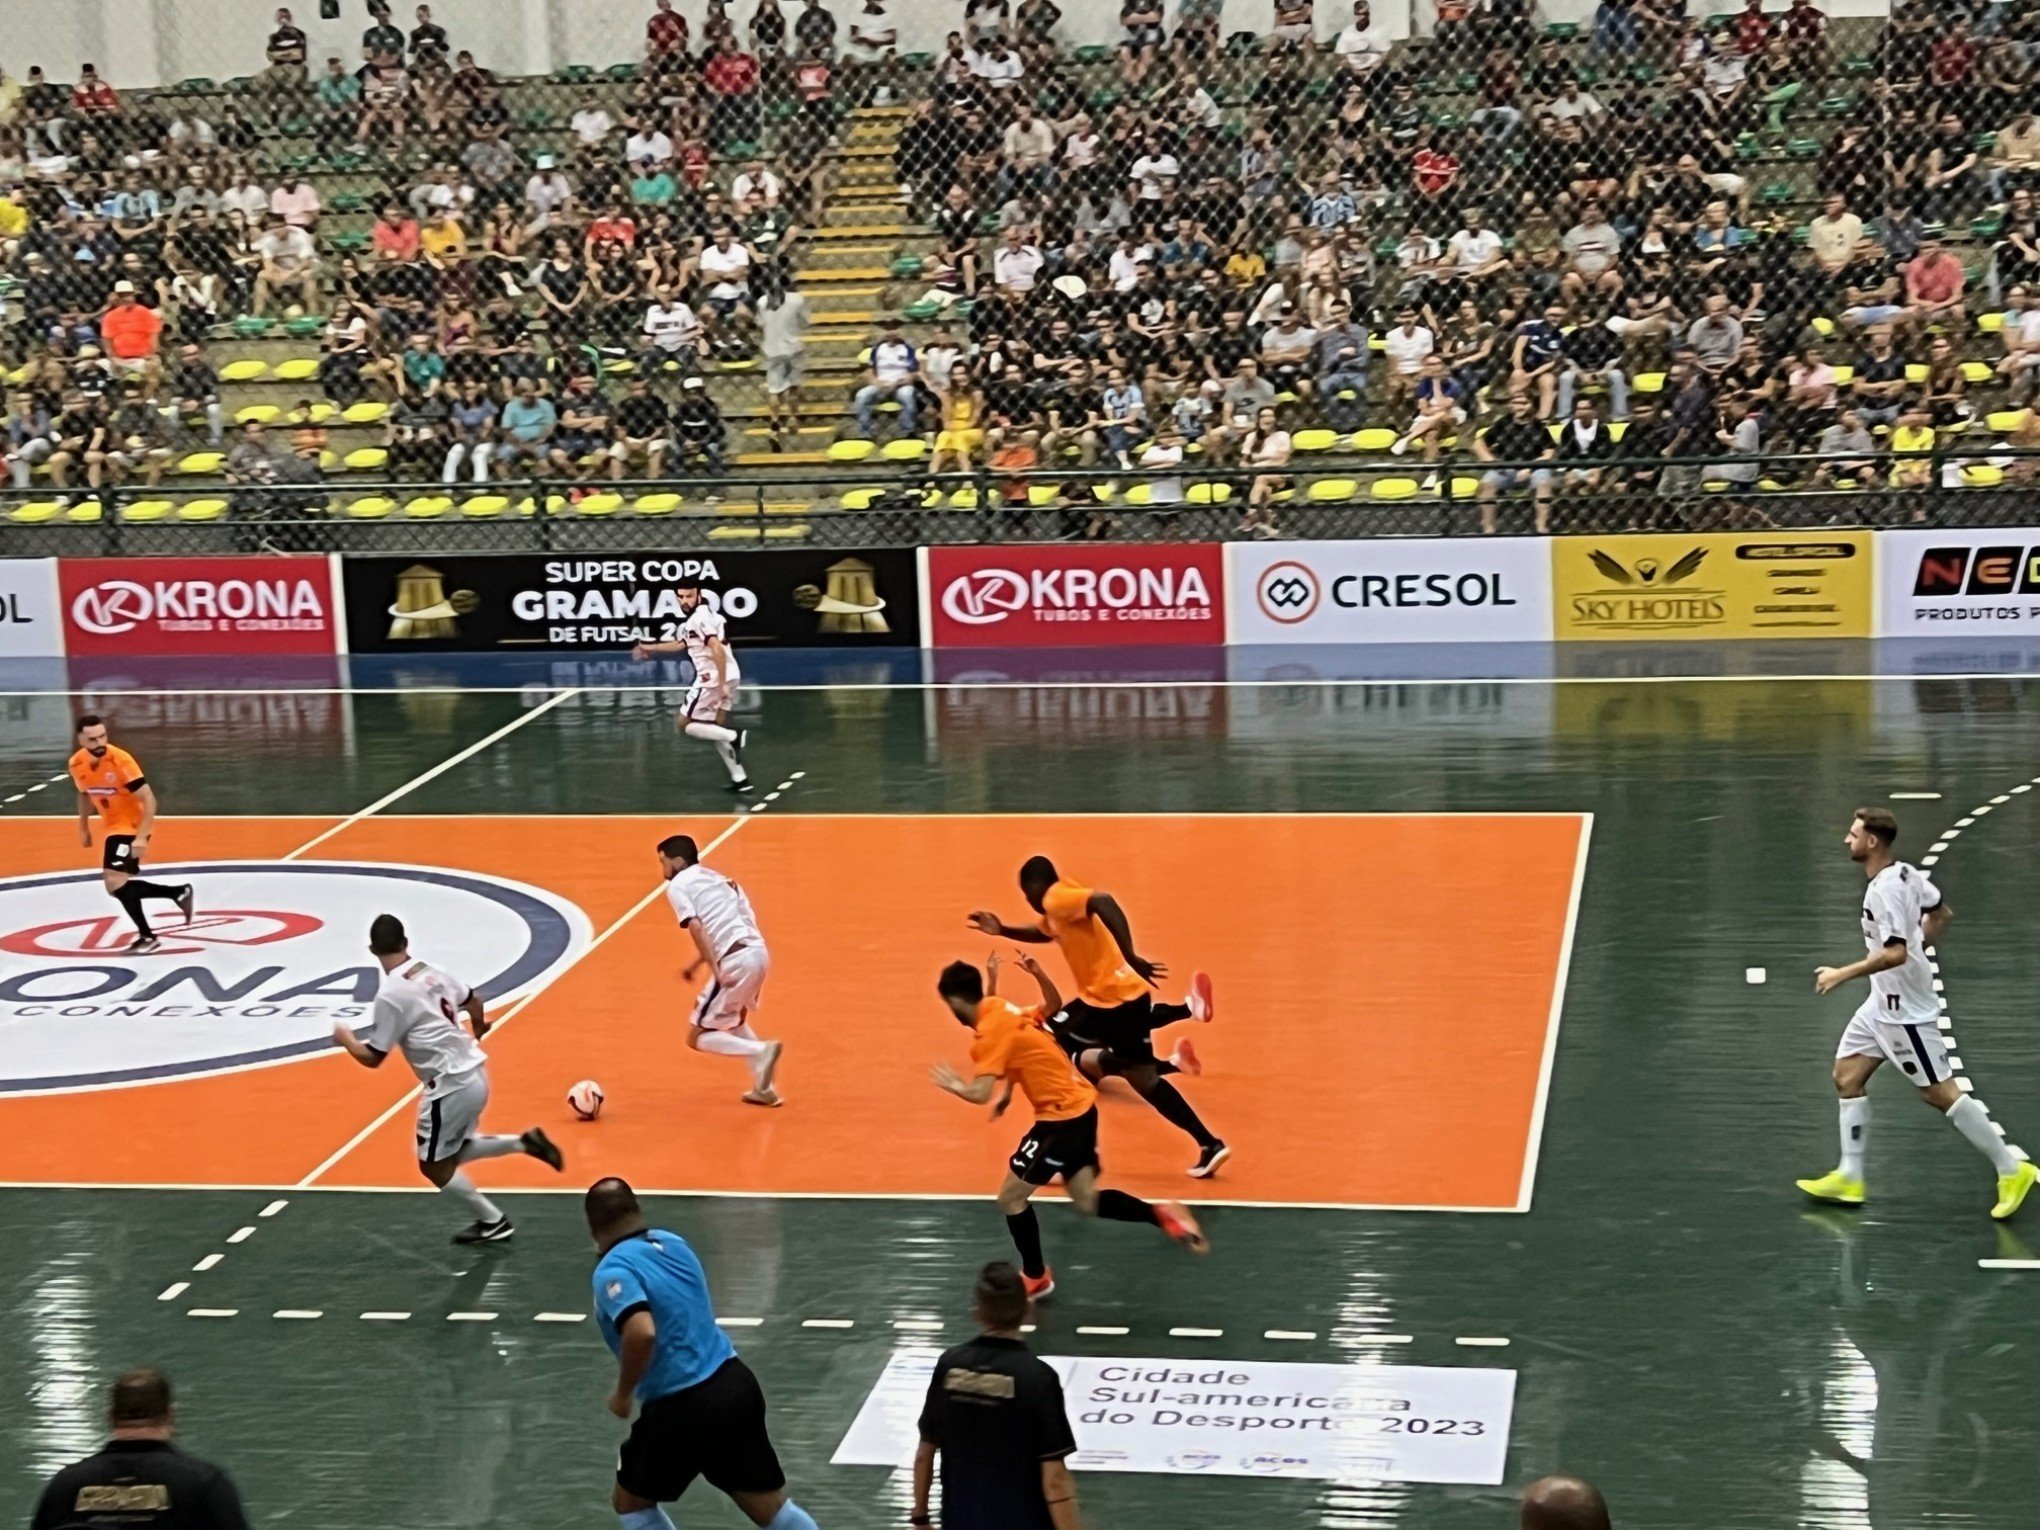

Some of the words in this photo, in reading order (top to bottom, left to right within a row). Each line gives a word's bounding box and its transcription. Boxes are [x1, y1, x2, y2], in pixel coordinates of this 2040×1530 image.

[545, 561, 636, 582] SUPER
[642, 560, 720, 581] COPA
[154, 580, 324, 618] KRONA
[1031, 567, 1211, 608] KRONA
[1332, 573, 1517, 608] CRESOL
[0, 593, 34, 623] L
[1032, 609, 1092, 621] TUBOS
[1098, 609, 1110, 621] E
[1570, 597, 1621, 622] SKY
[1628, 595, 1725, 620] HOTELS
[1915, 607, 2021, 620] PRODUTOS
[549, 626, 577, 643] DE
[581, 625, 657, 643] FUTSAL
[1021, 1138, 1039, 1159] 12
[1099, 1366, 1251, 1386] Cidade
[1080, 1409, 1135, 1425] do
[1379, 1417, 1486, 1437] 2023
